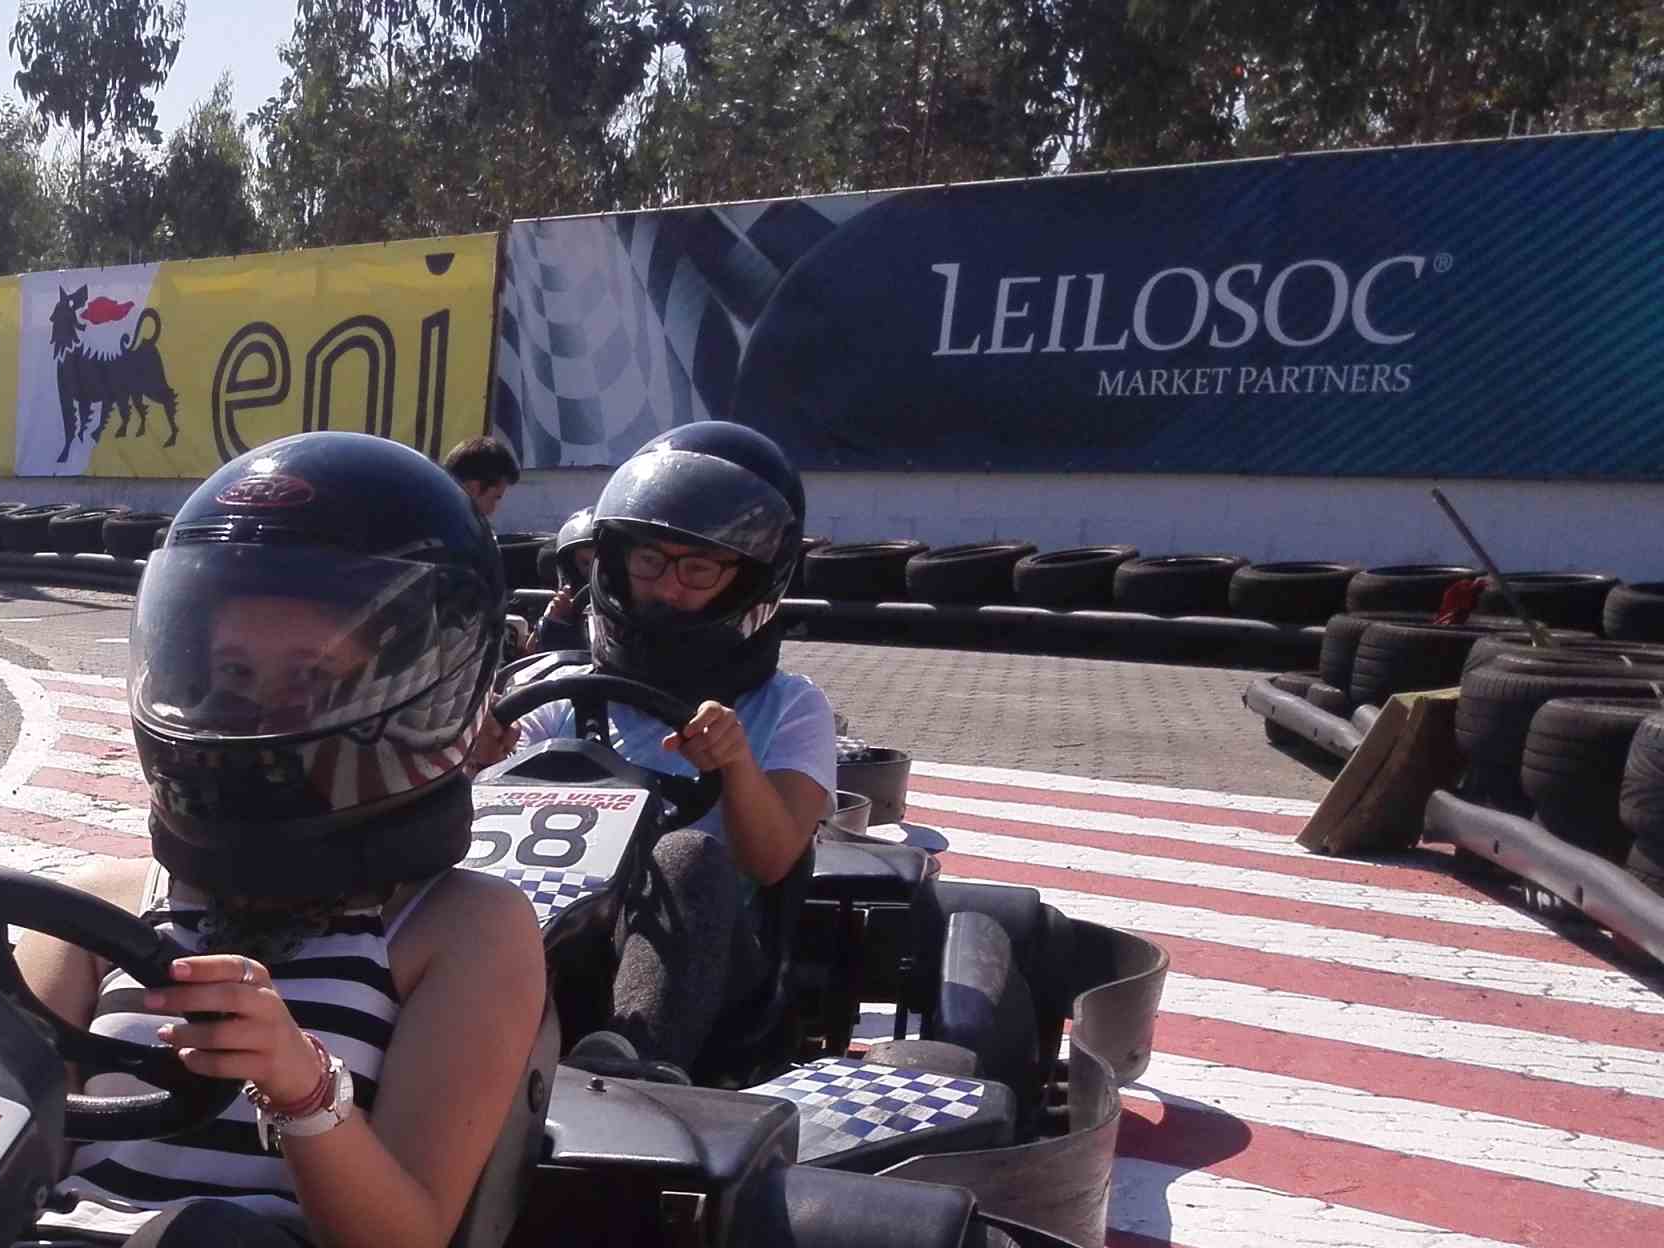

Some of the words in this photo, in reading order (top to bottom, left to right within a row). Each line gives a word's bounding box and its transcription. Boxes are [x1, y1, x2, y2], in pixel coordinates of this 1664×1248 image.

[212, 252, 455, 464] eni
[1096, 367, 1232, 396] MARKET
[1237, 363, 1413, 394] PARTNERS
[509, 792, 559, 801] BOA
[568, 793, 636, 802] VISTA
